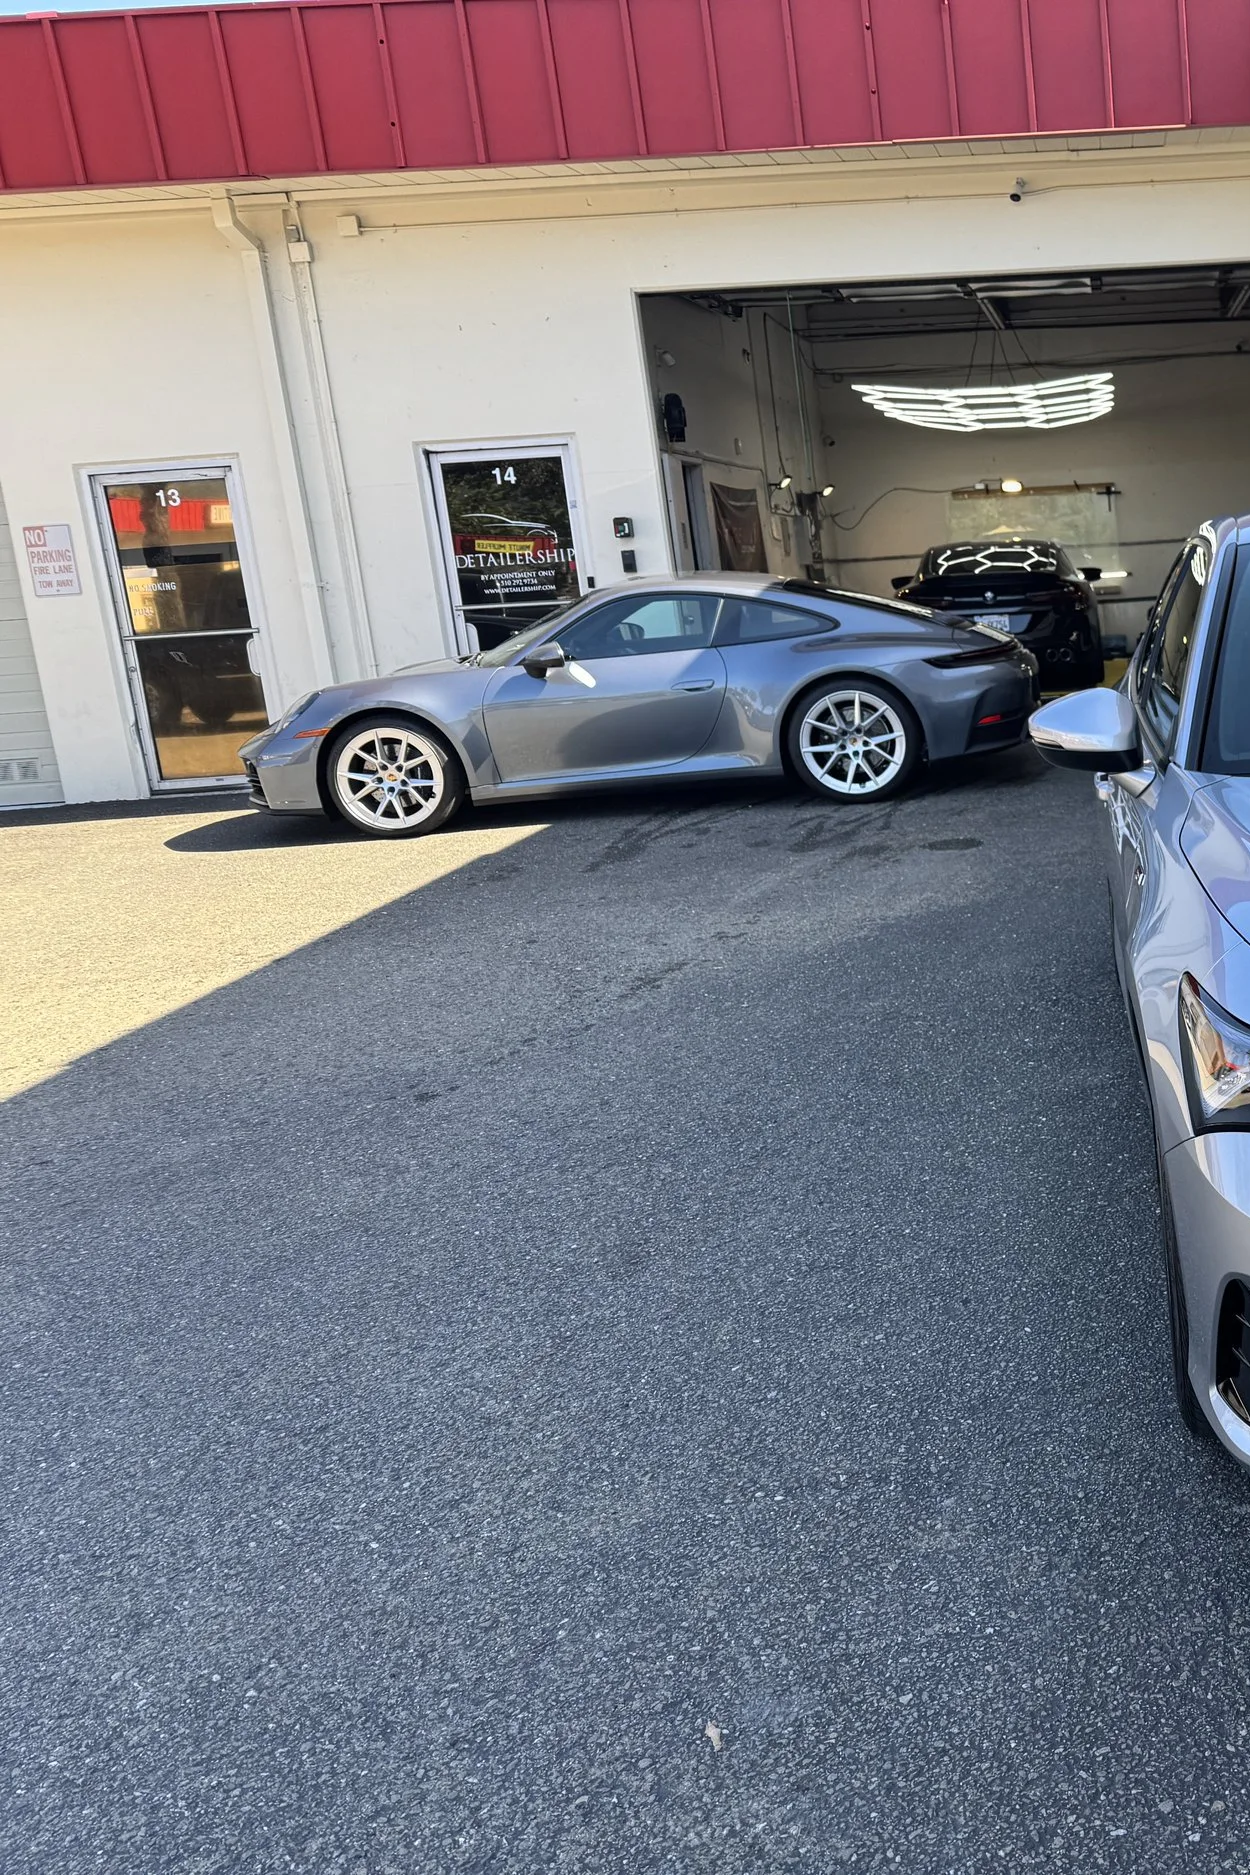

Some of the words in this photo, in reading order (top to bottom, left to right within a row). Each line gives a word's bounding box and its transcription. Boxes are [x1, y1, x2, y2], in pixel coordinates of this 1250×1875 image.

[491, 467, 517, 485] 14
[156, 489, 180, 506] 13
[24, 529, 45, 546] NO
[30, 549, 72, 564] PARKING
[455, 548, 576, 569] DETAILERSHIP
[33, 566, 51, 575] FIRE
[53, 564, 74, 574] LANE
[490, 571, 536, 580] APPOINTMENT
[39, 580, 53, 588] TOW
[56, 579, 73, 587] AWAY
[129, 584, 140, 592] NO
[141, 582, 177, 591] SMOKING
